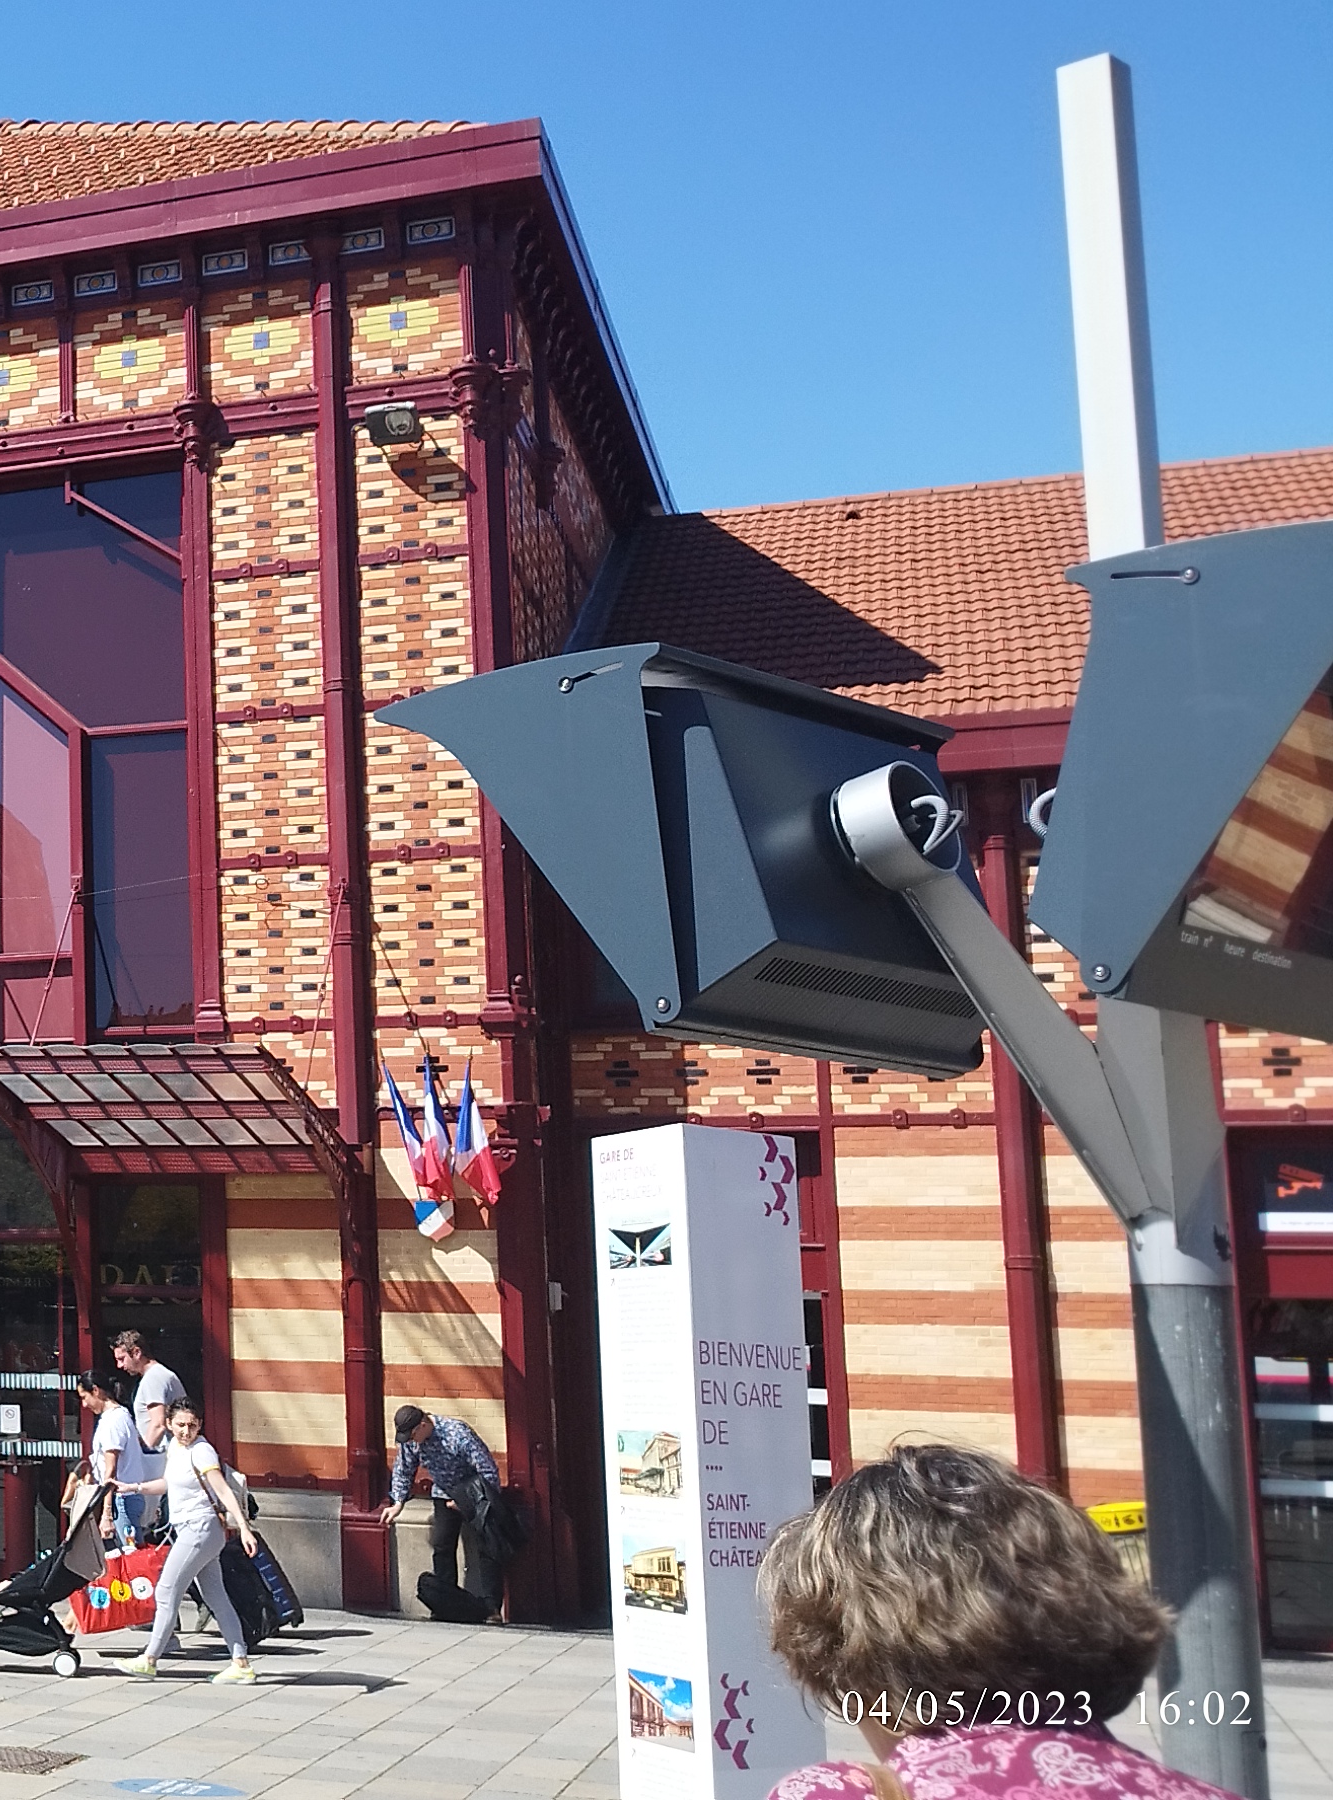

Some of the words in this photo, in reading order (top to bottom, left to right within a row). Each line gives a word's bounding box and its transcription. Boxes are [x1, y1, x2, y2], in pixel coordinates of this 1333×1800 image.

[1180, 929, 1200, 947] train
[1223, 940, 1246, 958] heure
[1251, 948, 1293, 970] destination
[599, 1149, 621, 1165] GARE
[623, 1147, 634, 1161] DE
[698, 1340, 803, 1371] BIENVENUE
[700, 1379, 728, 1406] EN
[733, 1380, 783, 1409] GARE
[702, 1419, 730, 1445] DE
[706, 1493, 751, 1512] SAINT-
[708, 1516, 767, 1540] ÉTIENNE
